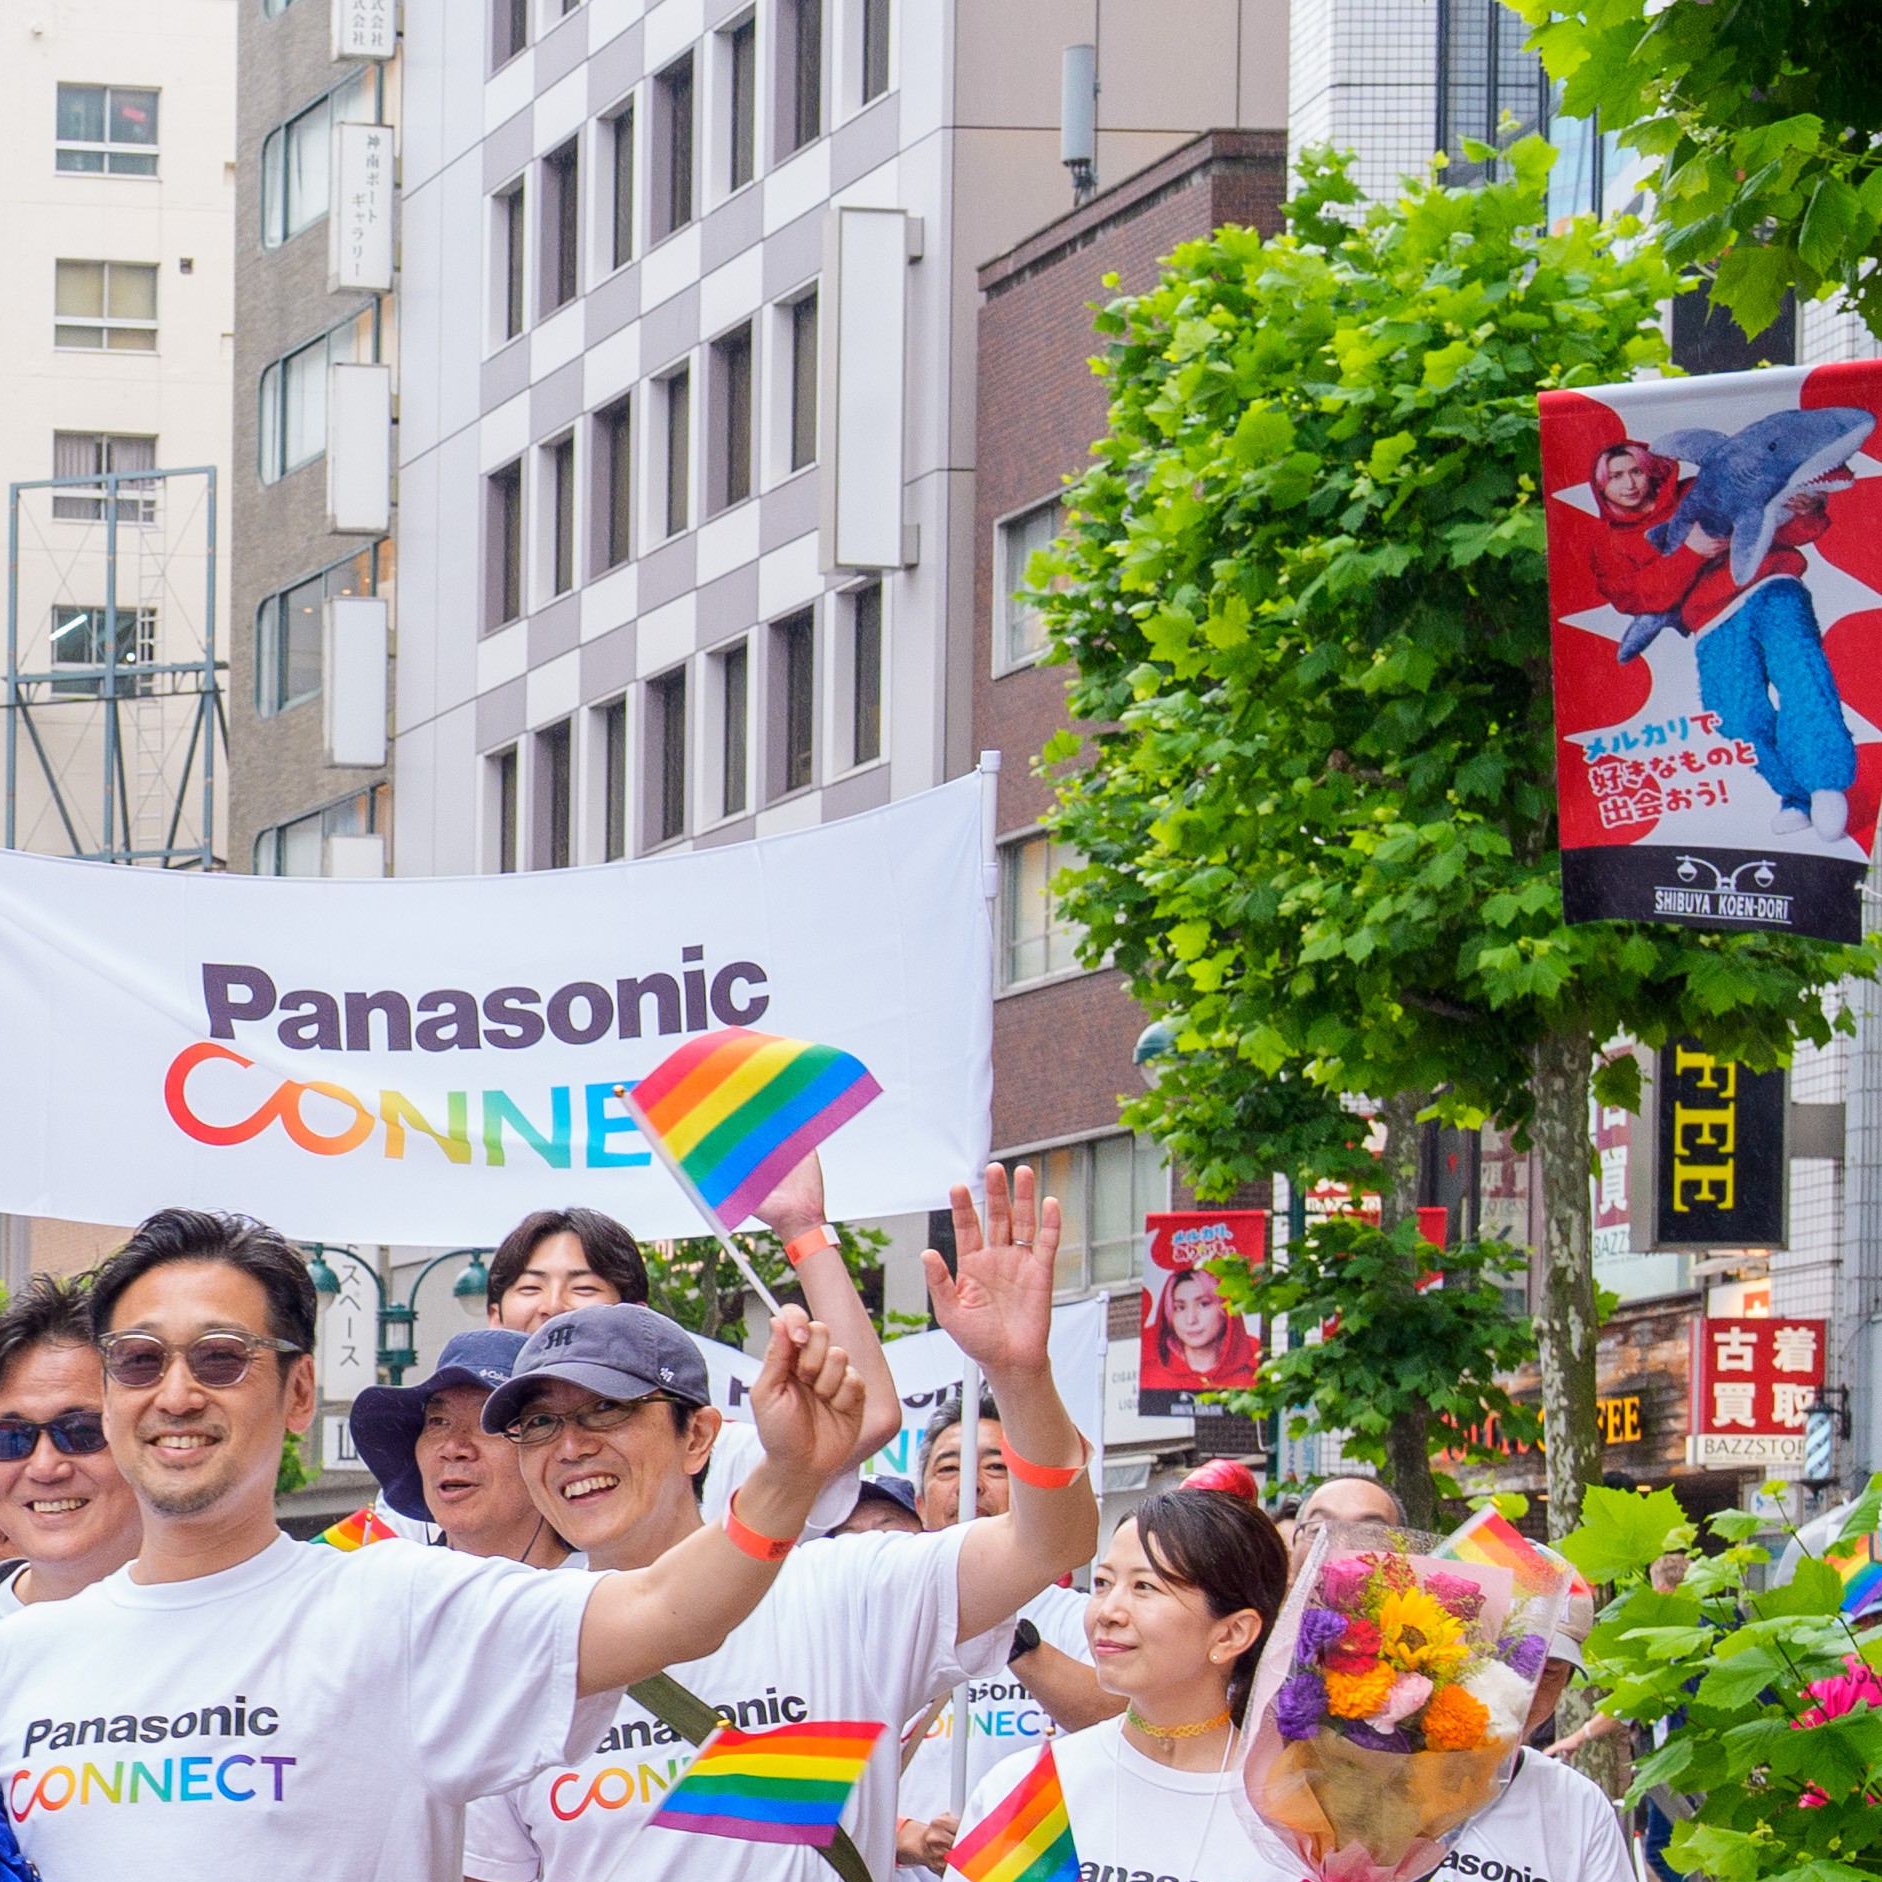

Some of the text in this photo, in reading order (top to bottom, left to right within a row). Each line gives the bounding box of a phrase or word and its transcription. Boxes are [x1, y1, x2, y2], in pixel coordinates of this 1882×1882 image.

[1584, 712, 1723, 762] メルカリで
[1589, 740, 1758, 797] 好きなものと
[1655, 889, 1789, 921] SHIBUYA KOEN-DORI
[201, 945, 770, 1052] Panasonic
[164, 1042, 652, 1169] CONNE
[1712, 1325, 1817, 1374] 古着
[22, 1695, 279, 1758] Panasonic
[595, 1686, 808, 1755] anaonic
[9, 1754, 297, 1823] CONNECT
